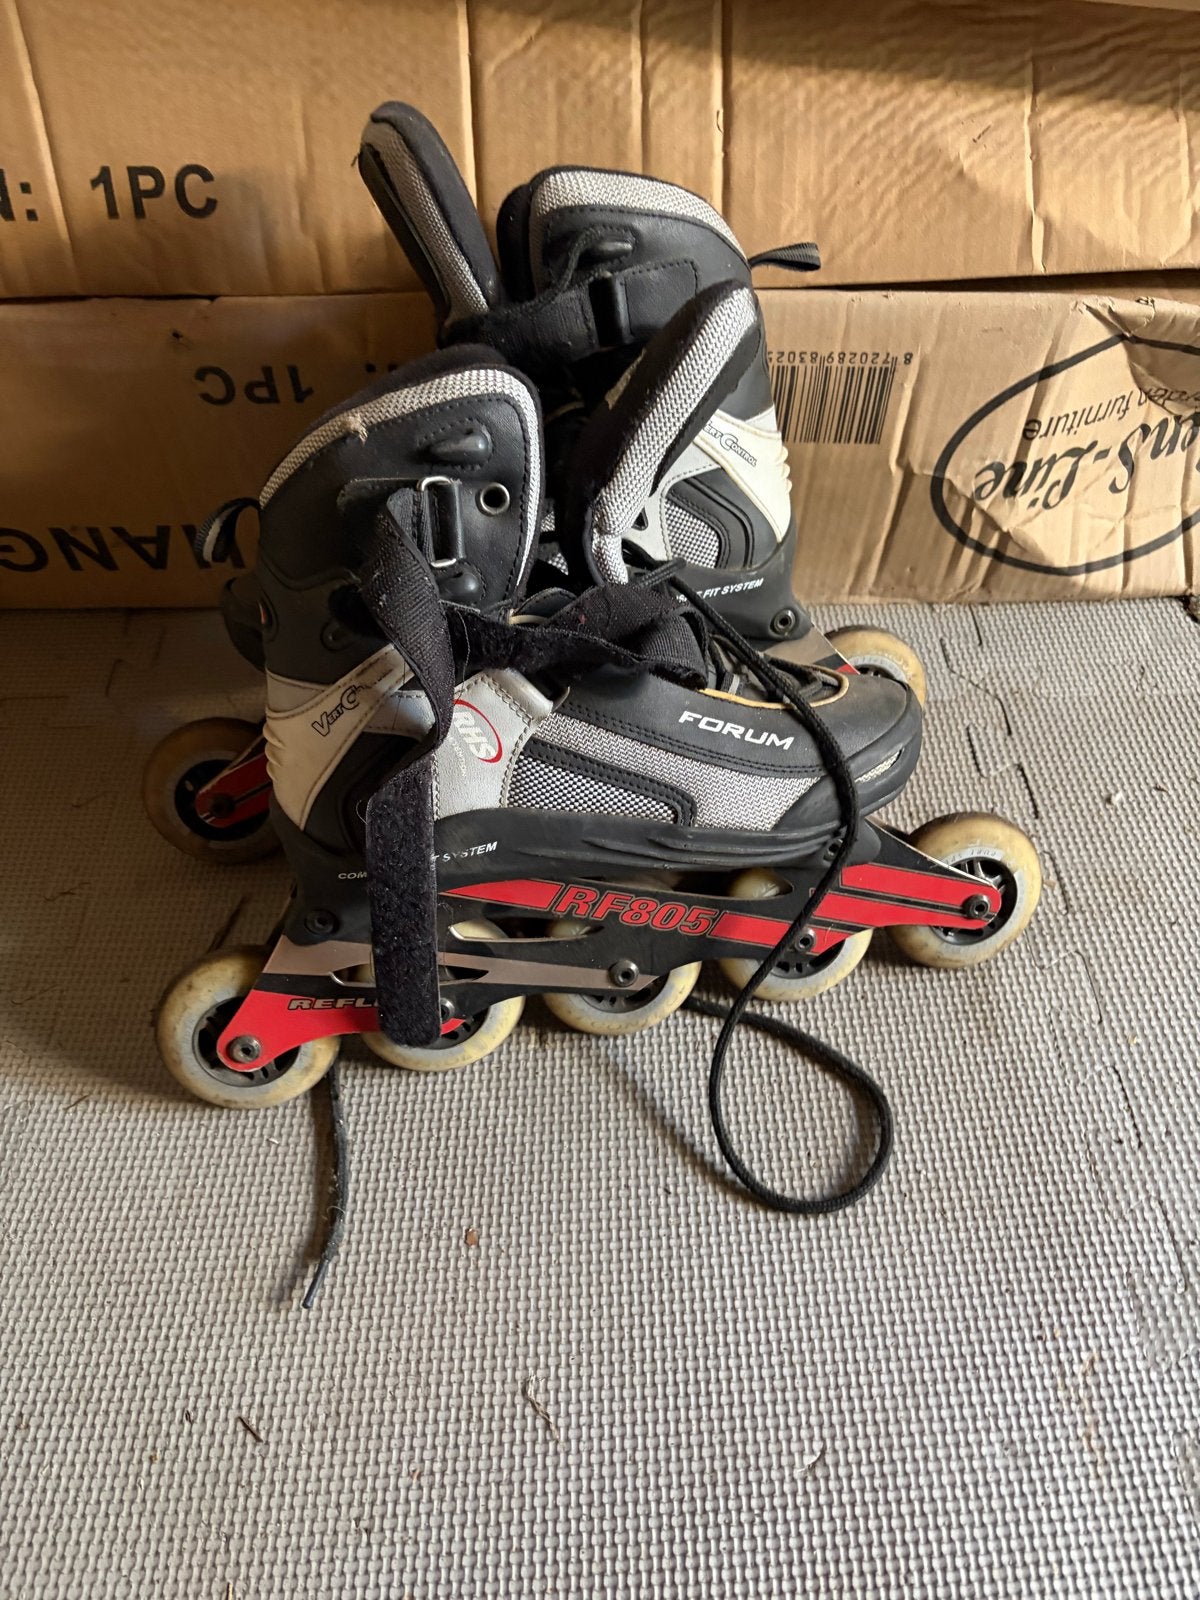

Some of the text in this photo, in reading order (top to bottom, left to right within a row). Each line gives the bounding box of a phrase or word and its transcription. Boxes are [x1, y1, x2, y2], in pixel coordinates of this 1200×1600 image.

[90, 164, 218, 219] 1PC
[195, 365, 314, 405] 1PC
[1022, 390, 1133, 441] furniture
[702, 587, 721, 599] FIT
[721, 578, 764, 595] SYSTEM
[452, 711, 498, 759] RHS
[678, 710, 795, 750] FORUM
[553, 884, 719, 936] RF805
[288, 997, 380, 1010] REFL
